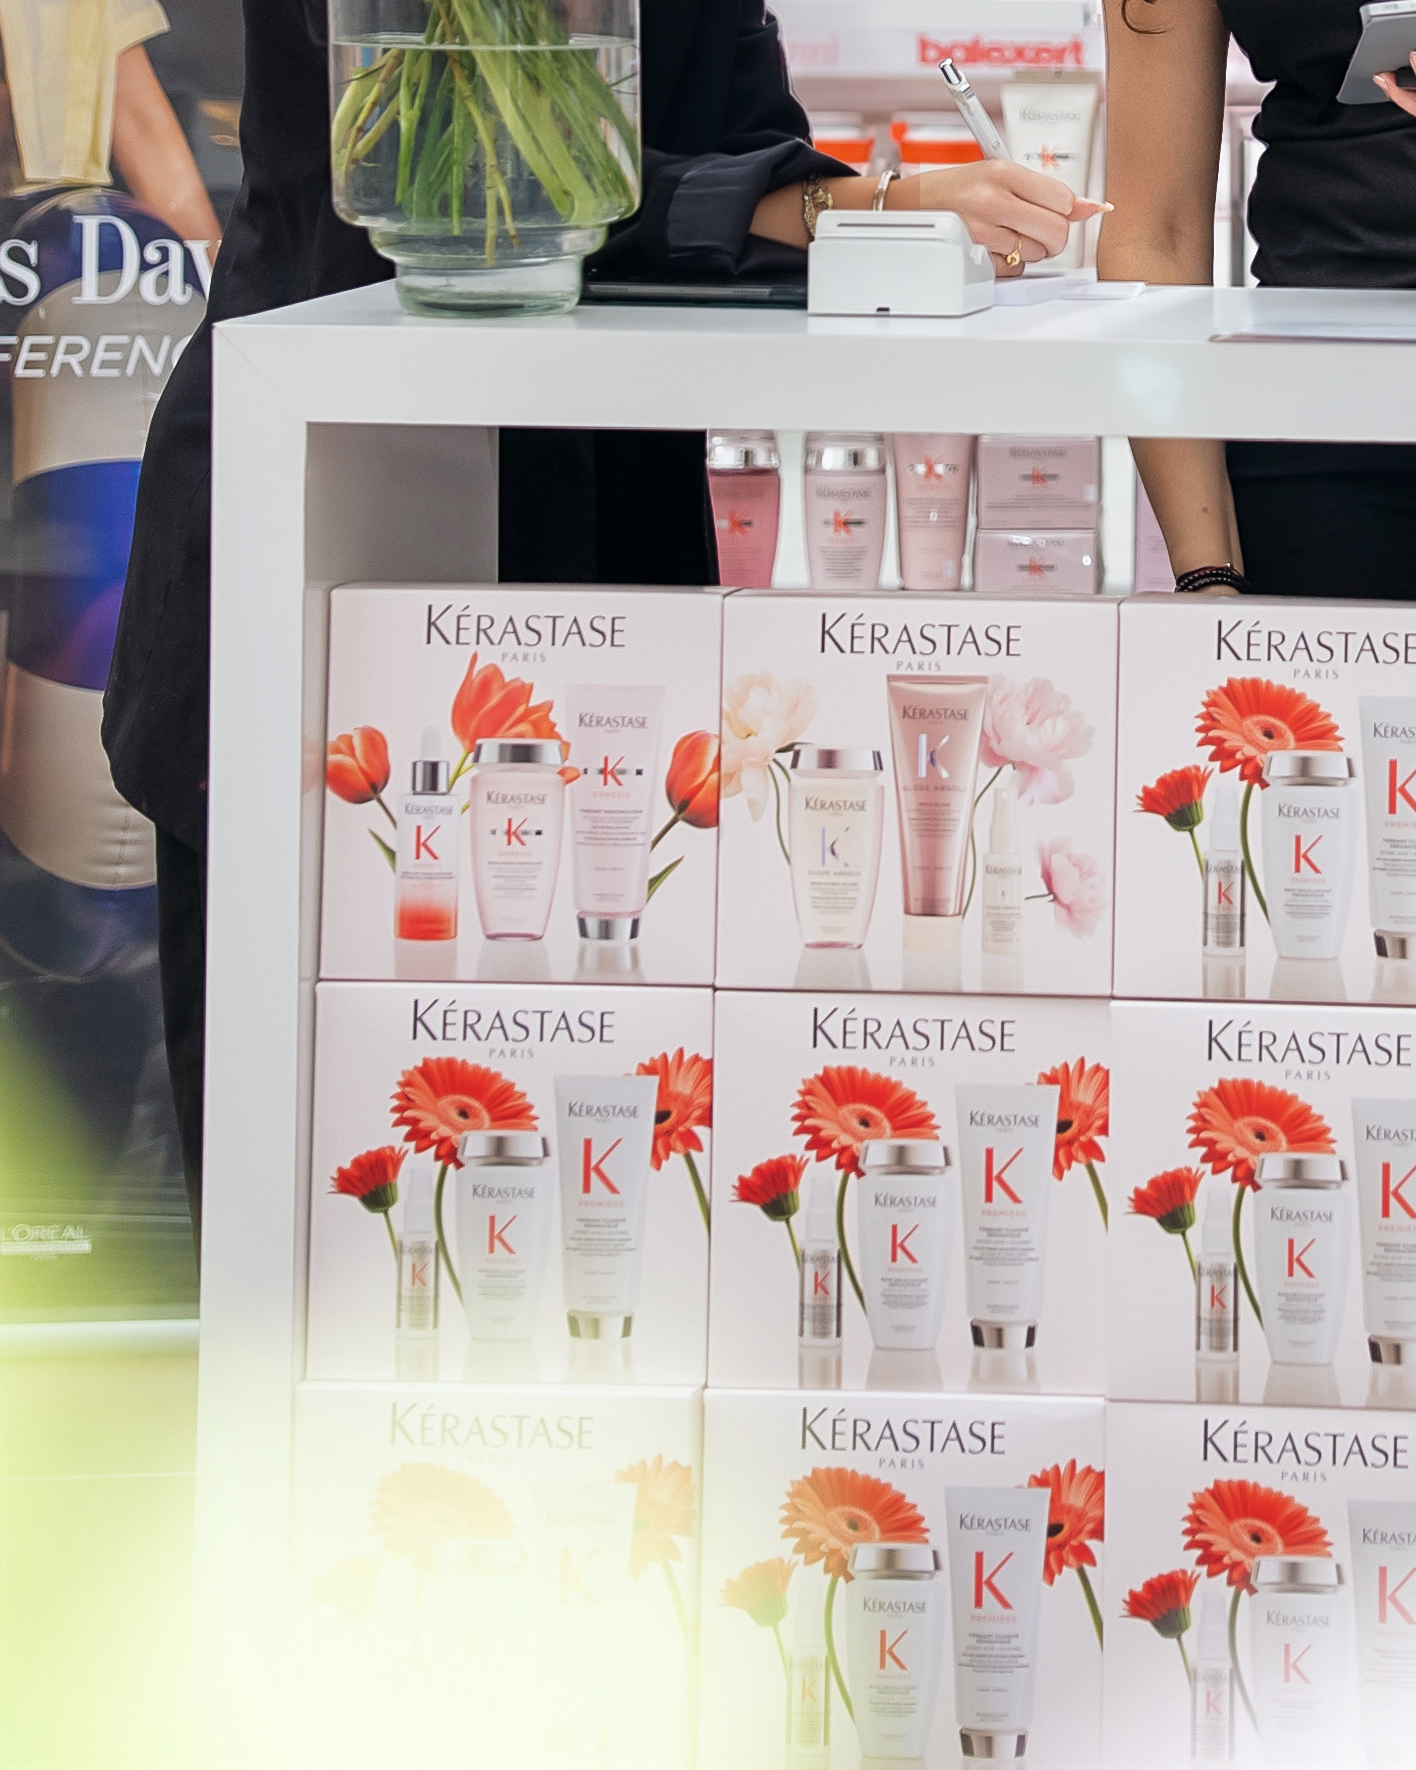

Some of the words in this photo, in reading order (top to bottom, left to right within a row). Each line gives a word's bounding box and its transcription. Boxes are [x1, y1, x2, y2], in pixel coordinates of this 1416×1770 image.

[0, 239, 41, 305] s
[426, 603, 626, 647] KÉRASTASE
[819, 613, 1022, 656] KÉRASTASE
[501, 651, 547, 663] PARIS
[896, 661, 942, 671] PARIS
[1293, 668, 1339, 679] PARIS
[579, 713, 647, 729] KÉRASTASE
[903, 705, 968, 721] KÉRASTASE
[918, 733, 951, 778] K
[603, 755, 624, 786] K
[486, 790, 547, 805] KÉRASTASE
[805, 796, 866, 811] KÉRASTASE
[1278, 803, 1340, 819] KÉRASTASE
[415, 825, 441, 860] K
[507, 818, 528, 846] K
[1294, 834, 1324, 874] K
[1218, 881, 1234, 904] K
[412, 998, 615, 1044] KÉRASTASE
[812, 1006, 1016, 1053] KÉRASTASE
[489, 1047, 535, 1059] PARIS
[1208, 1019, 1412, 1066] KÉRASTASE
[890, 1056, 935, 1067] PARIS
[1285, 1069, 1331, 1081] PARIS
[568, 1101, 639, 1118] KÉRASTASE
[970, 1110, 1040, 1127] KÉRASTASE
[583, 1138, 623, 1195] K
[985, 1147, 1024, 1204] K
[473, 1184, 535, 1199] KÉRASTASE
[874, 1192, 936, 1208] KÉRASTASE
[1271, 1206, 1333, 1222] KÉRASTASE
[488, 1214, 518, 1255] K
[891, 1223, 920, 1264] K
[1287, 1237, 1316, 1278] K
[411, 1263, 428, 1287] K
[814, 1271, 830, 1294] K
[1210, 1285, 1227, 1308] K
[389, 1401, 593, 1450] KÉRASTASE
[801, 1406, 1007, 1455] KÉRASTASE
[1203, 1418, 1409, 1469] KÉRASTASE
[878, 1458, 925, 1470] PARIS
[1281, 1471, 1328, 1483] PARIS
[959, 1513, 1032, 1532] KÉRASTASE
[560, 1547, 599, 1605] K
[974, 1551, 1014, 1609] K
[864, 1598, 926, 1614] KÉRASTASE
[879, 1628, 909, 1670] K
[1284, 1643, 1312, 1684] K
[1206, 1690, 1222, 1715] K
